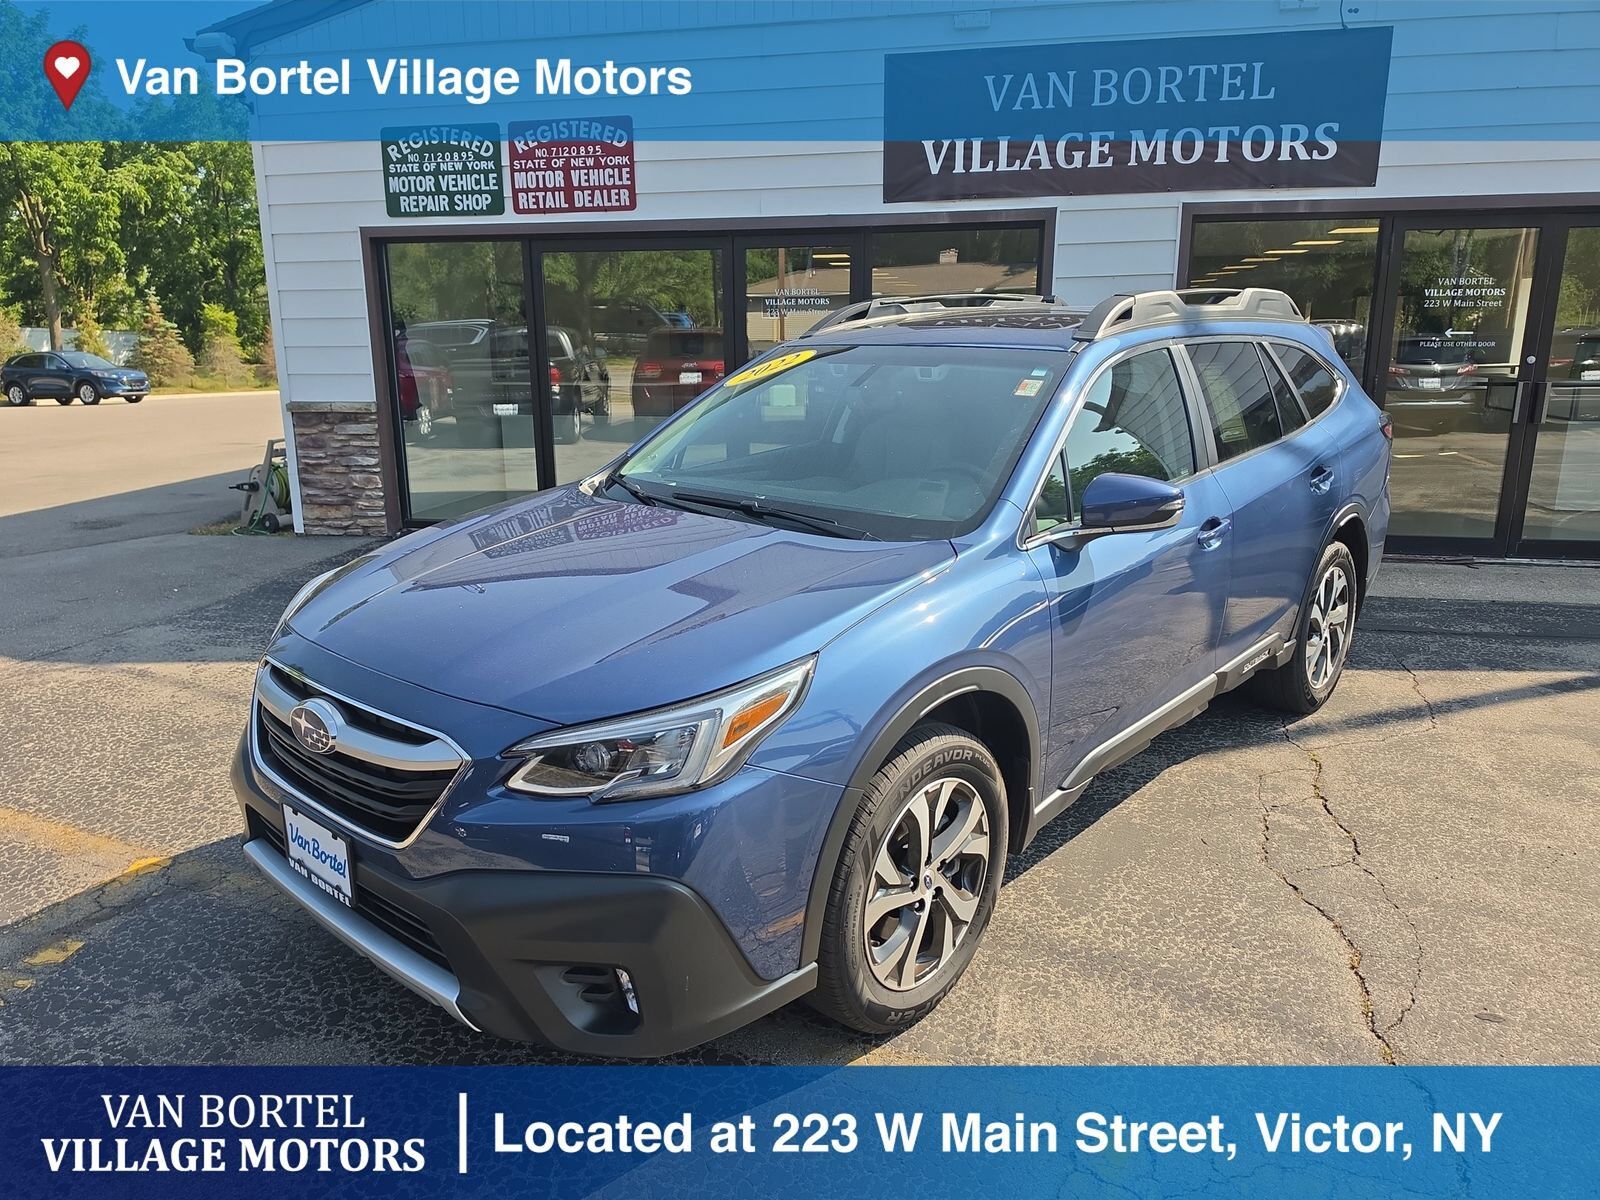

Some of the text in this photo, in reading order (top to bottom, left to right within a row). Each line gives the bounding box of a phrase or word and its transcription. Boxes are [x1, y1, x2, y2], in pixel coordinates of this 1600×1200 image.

[984, 61, 1276, 112] VAN BORTEL
[387, 127, 494, 162] REGISTERED
[513, 120, 628, 154] REGISTERED
[535, 145, 602, 158] NO. 7120895
[921, 122, 1341, 175] VILLAGE MOTORS
[407, 153, 421, 163] NO.
[513, 155, 630, 170] STATE OF NEW YORK
[389, 160, 495, 173] STATE OF NEW YORK
[388, 173, 498, 193] MOTOR VEHICLE
[514, 168, 631, 189] MOTOR VEHICLE
[400, 194, 492, 212] REPAIR SHOP
[518, 188, 630, 209] RETAIL DEALER
[1438, 277, 1495, 286] VAN BORTEL
[774, 288, 820, 296] VAN BORTEL
[1424, 288, 1506, 297] VILLAGE MOTORS
[765, 297, 830, 306] VILLAGE MOTORS
[1424, 299, 1502, 308] 223 W Main Street
[288, 857, 352, 908] VAN BORTEL
